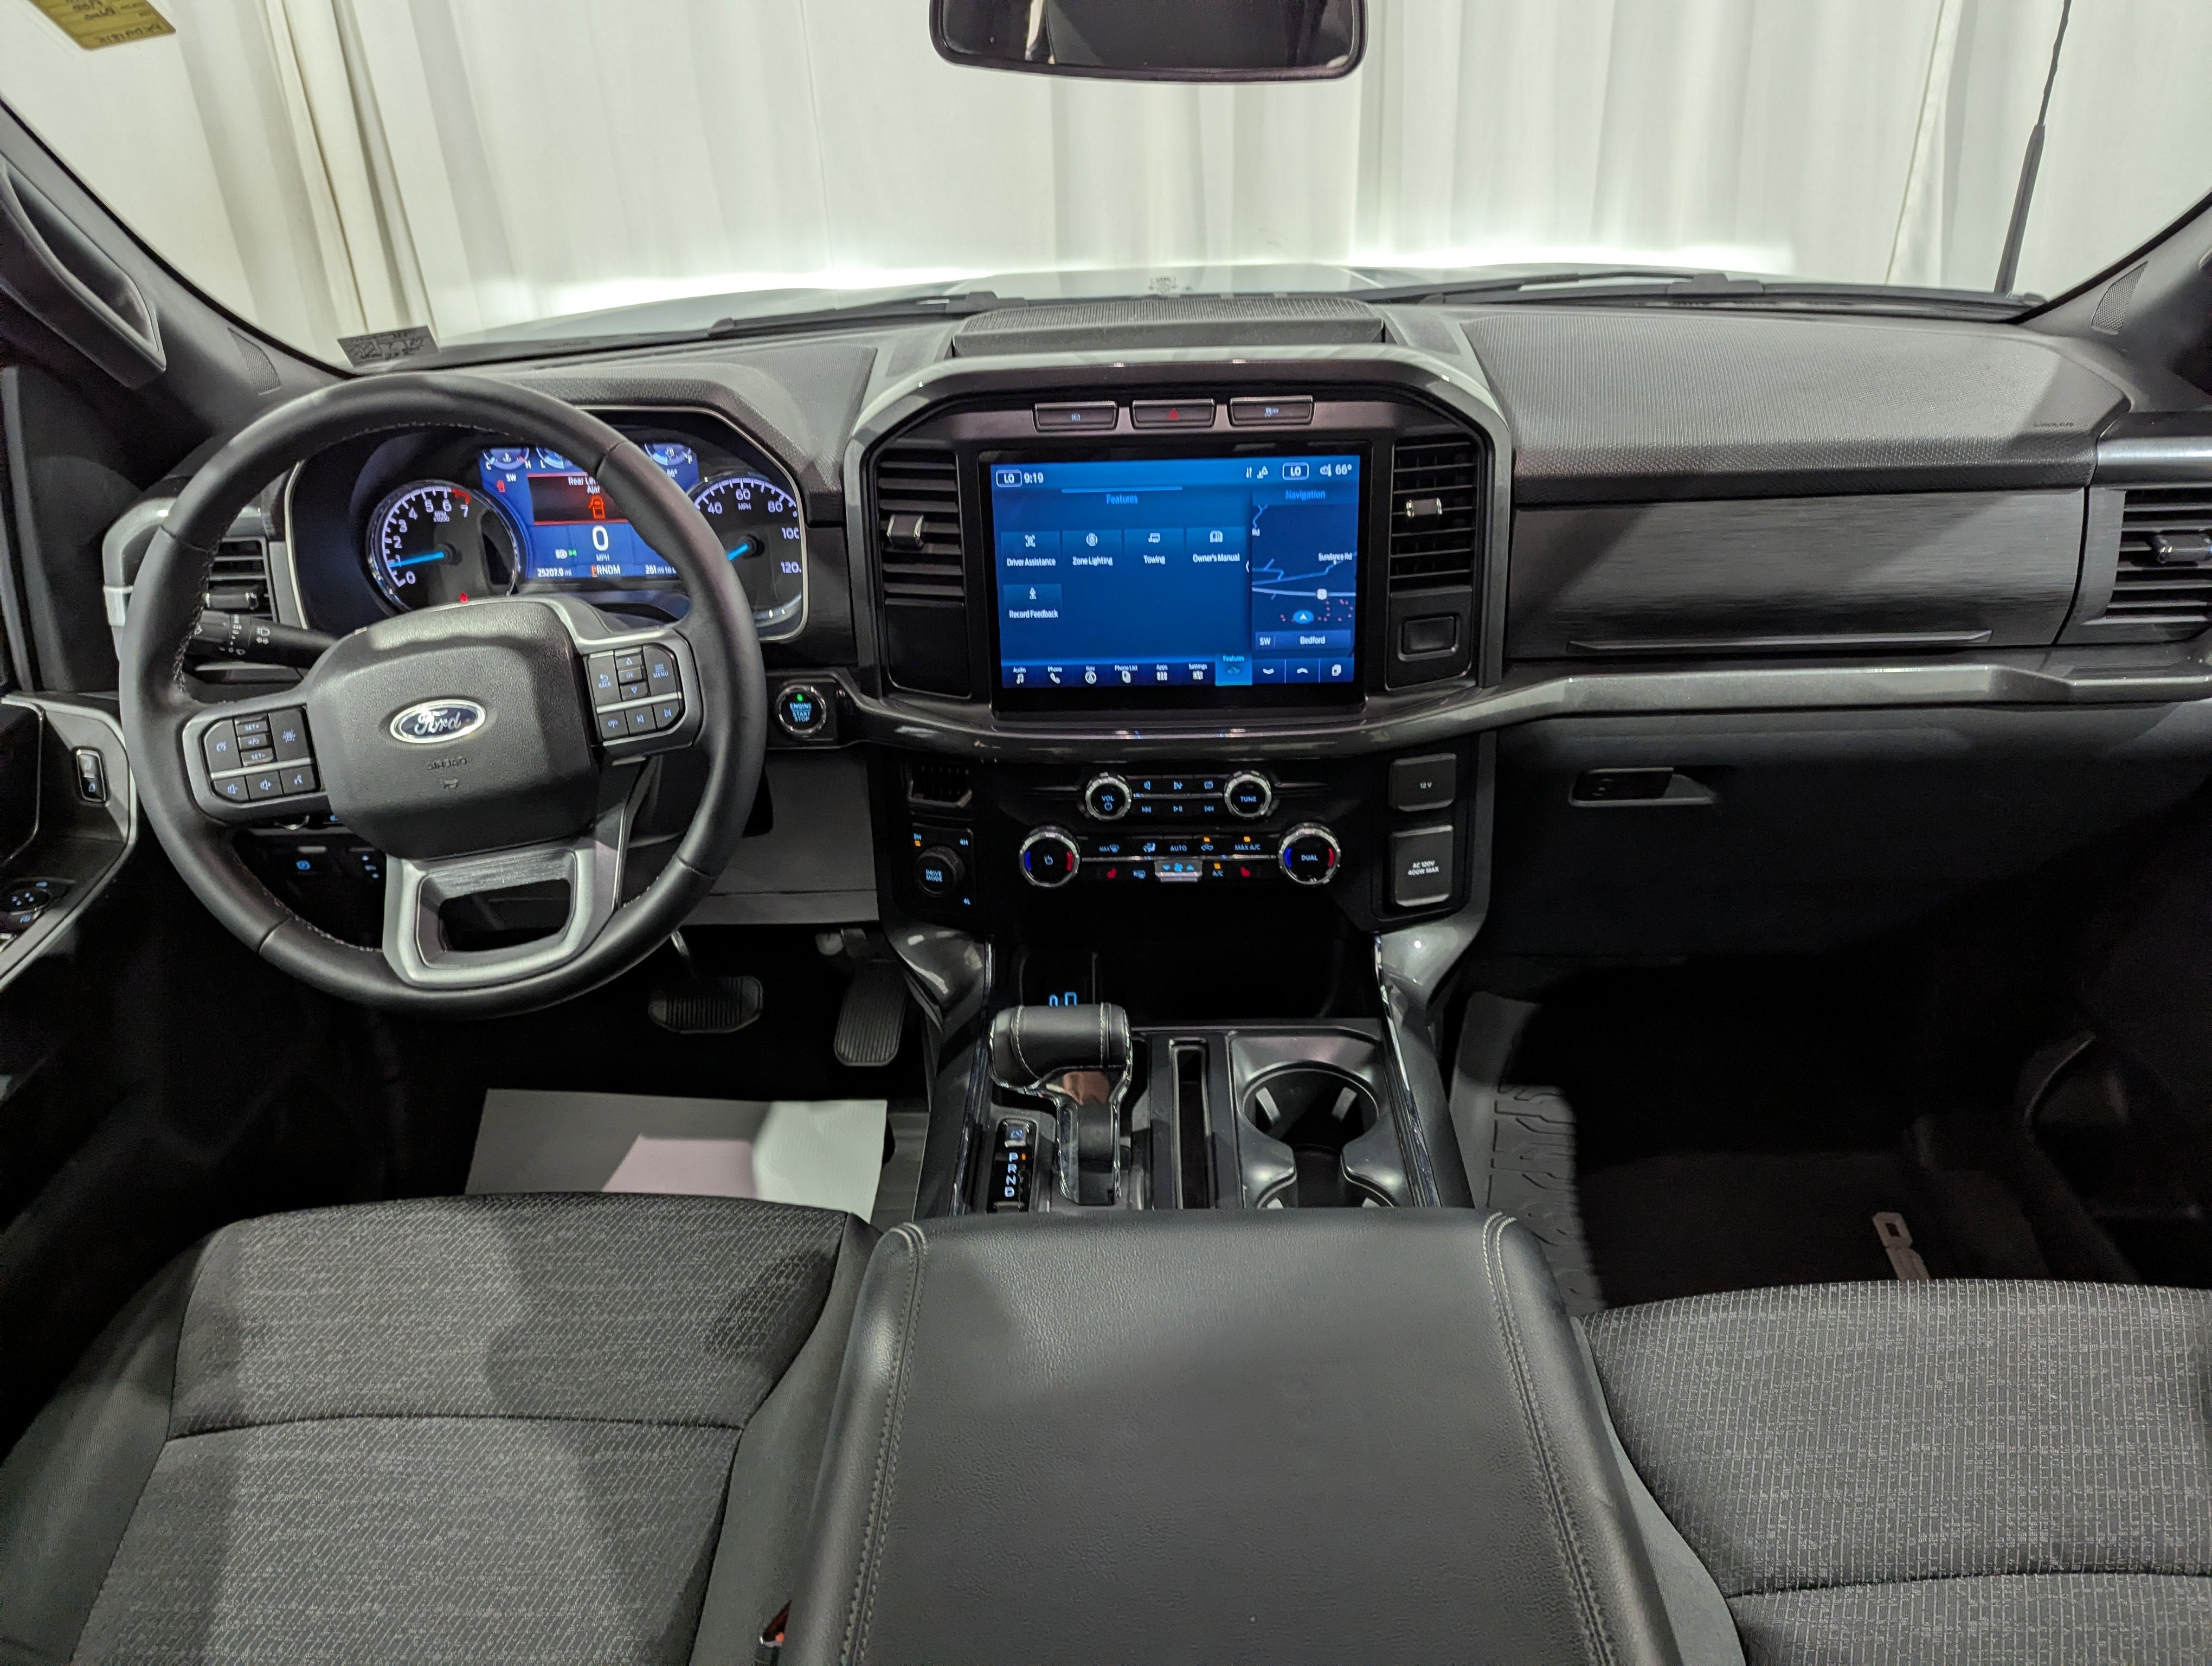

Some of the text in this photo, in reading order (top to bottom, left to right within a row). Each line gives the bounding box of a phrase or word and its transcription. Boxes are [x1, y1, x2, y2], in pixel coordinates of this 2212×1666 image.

[1290, 466, 1301, 476] LO
[506, 473, 516, 482] SW
[568, 477, 583, 486] Rear
[1004, 472, 1044, 484] LO 9:19
[587, 484, 600, 495] Ajar
[736, 488, 751, 500] 60
[1107, 494, 1137, 504] Features
[1285, 490, 1326, 501] Navigation
[425, 499, 434, 512] 5
[442, 499, 452, 511] 6
[460, 504, 468, 517] 7
[708, 502, 723, 514] 40
[768, 500, 783, 512] 80
[408, 507, 418, 520] 4
[398, 519, 407, 533] 3
[592, 525, 609, 551] 0
[781, 527, 799, 539] 100
[393, 535, 402, 549] 2
[1072, 556, 1113, 566] Zone Lighting
[1143, 555, 1165, 565] Towing
[1193, 553, 1240, 562] Owner's Manual
[1319, 552, 1352, 561] Sundance Rd
[781, 561, 799, 573] 120
[1007, 558, 1056, 567] Driver Assistance
[406, 571, 415, 584] 0
[1009, 609, 1058, 618] Record Feedback
[1259, 637, 1271, 646] SW
[1300, 636, 1326, 645] Bedford
[653, 670, 668, 678] MENU
[789, 702, 812, 710] ENGINE
[414, 709, 461, 735] Ford
